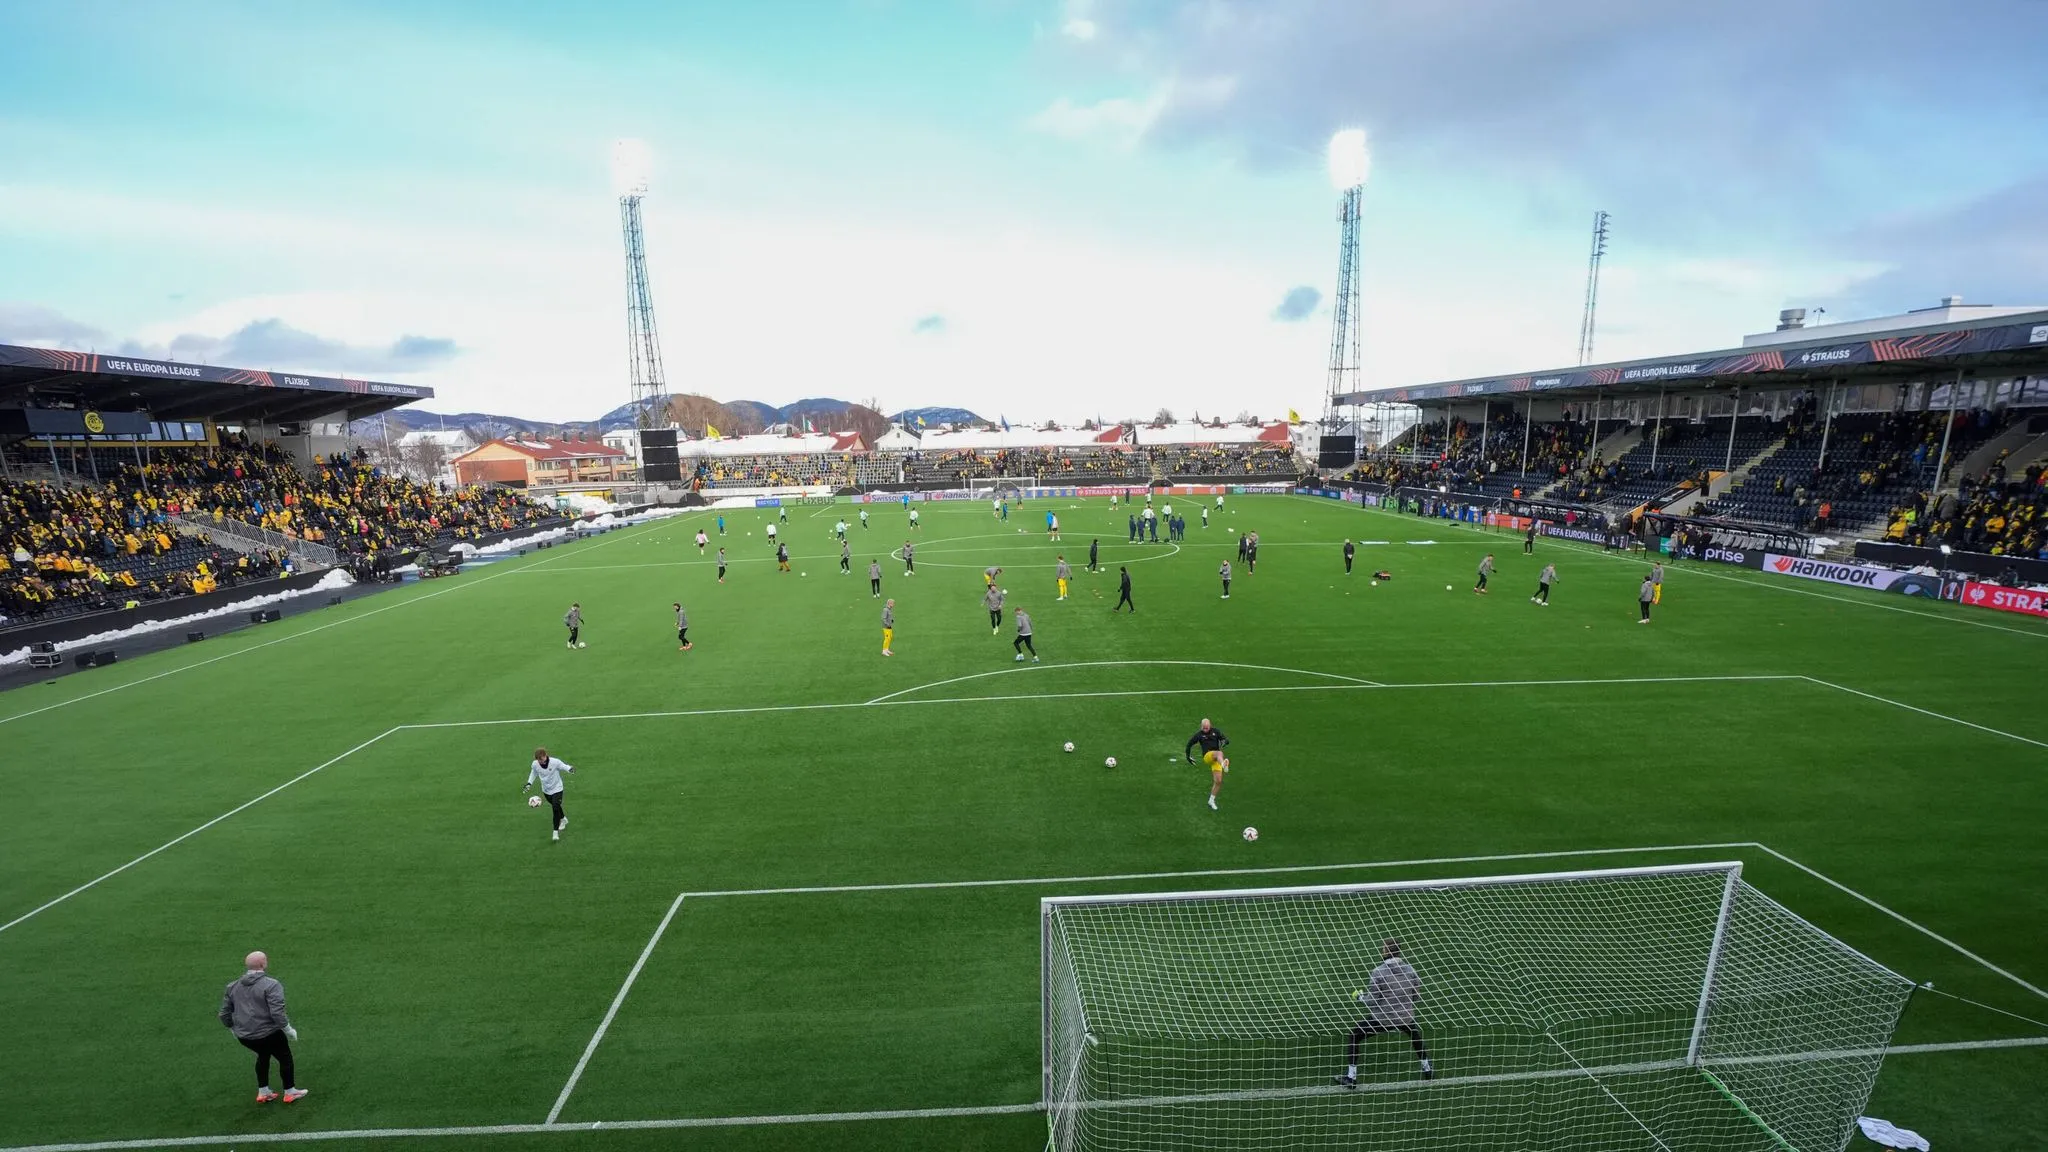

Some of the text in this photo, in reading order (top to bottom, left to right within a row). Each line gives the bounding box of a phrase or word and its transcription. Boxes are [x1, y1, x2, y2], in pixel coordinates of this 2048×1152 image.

[1810, 350, 1850, 361] STRAUSS
[107, 360, 201, 377] UEFA EUROPA LEAGUE
[1624, 364, 1697, 379] UEFA EUROPA LEAGUE
[371, 384, 385, 392] UEFA
[401, 387, 418, 395] LEAGUE
[1548, 527, 1564, 537] UEFA
[1565, 529, 1590, 540] EUROPA
